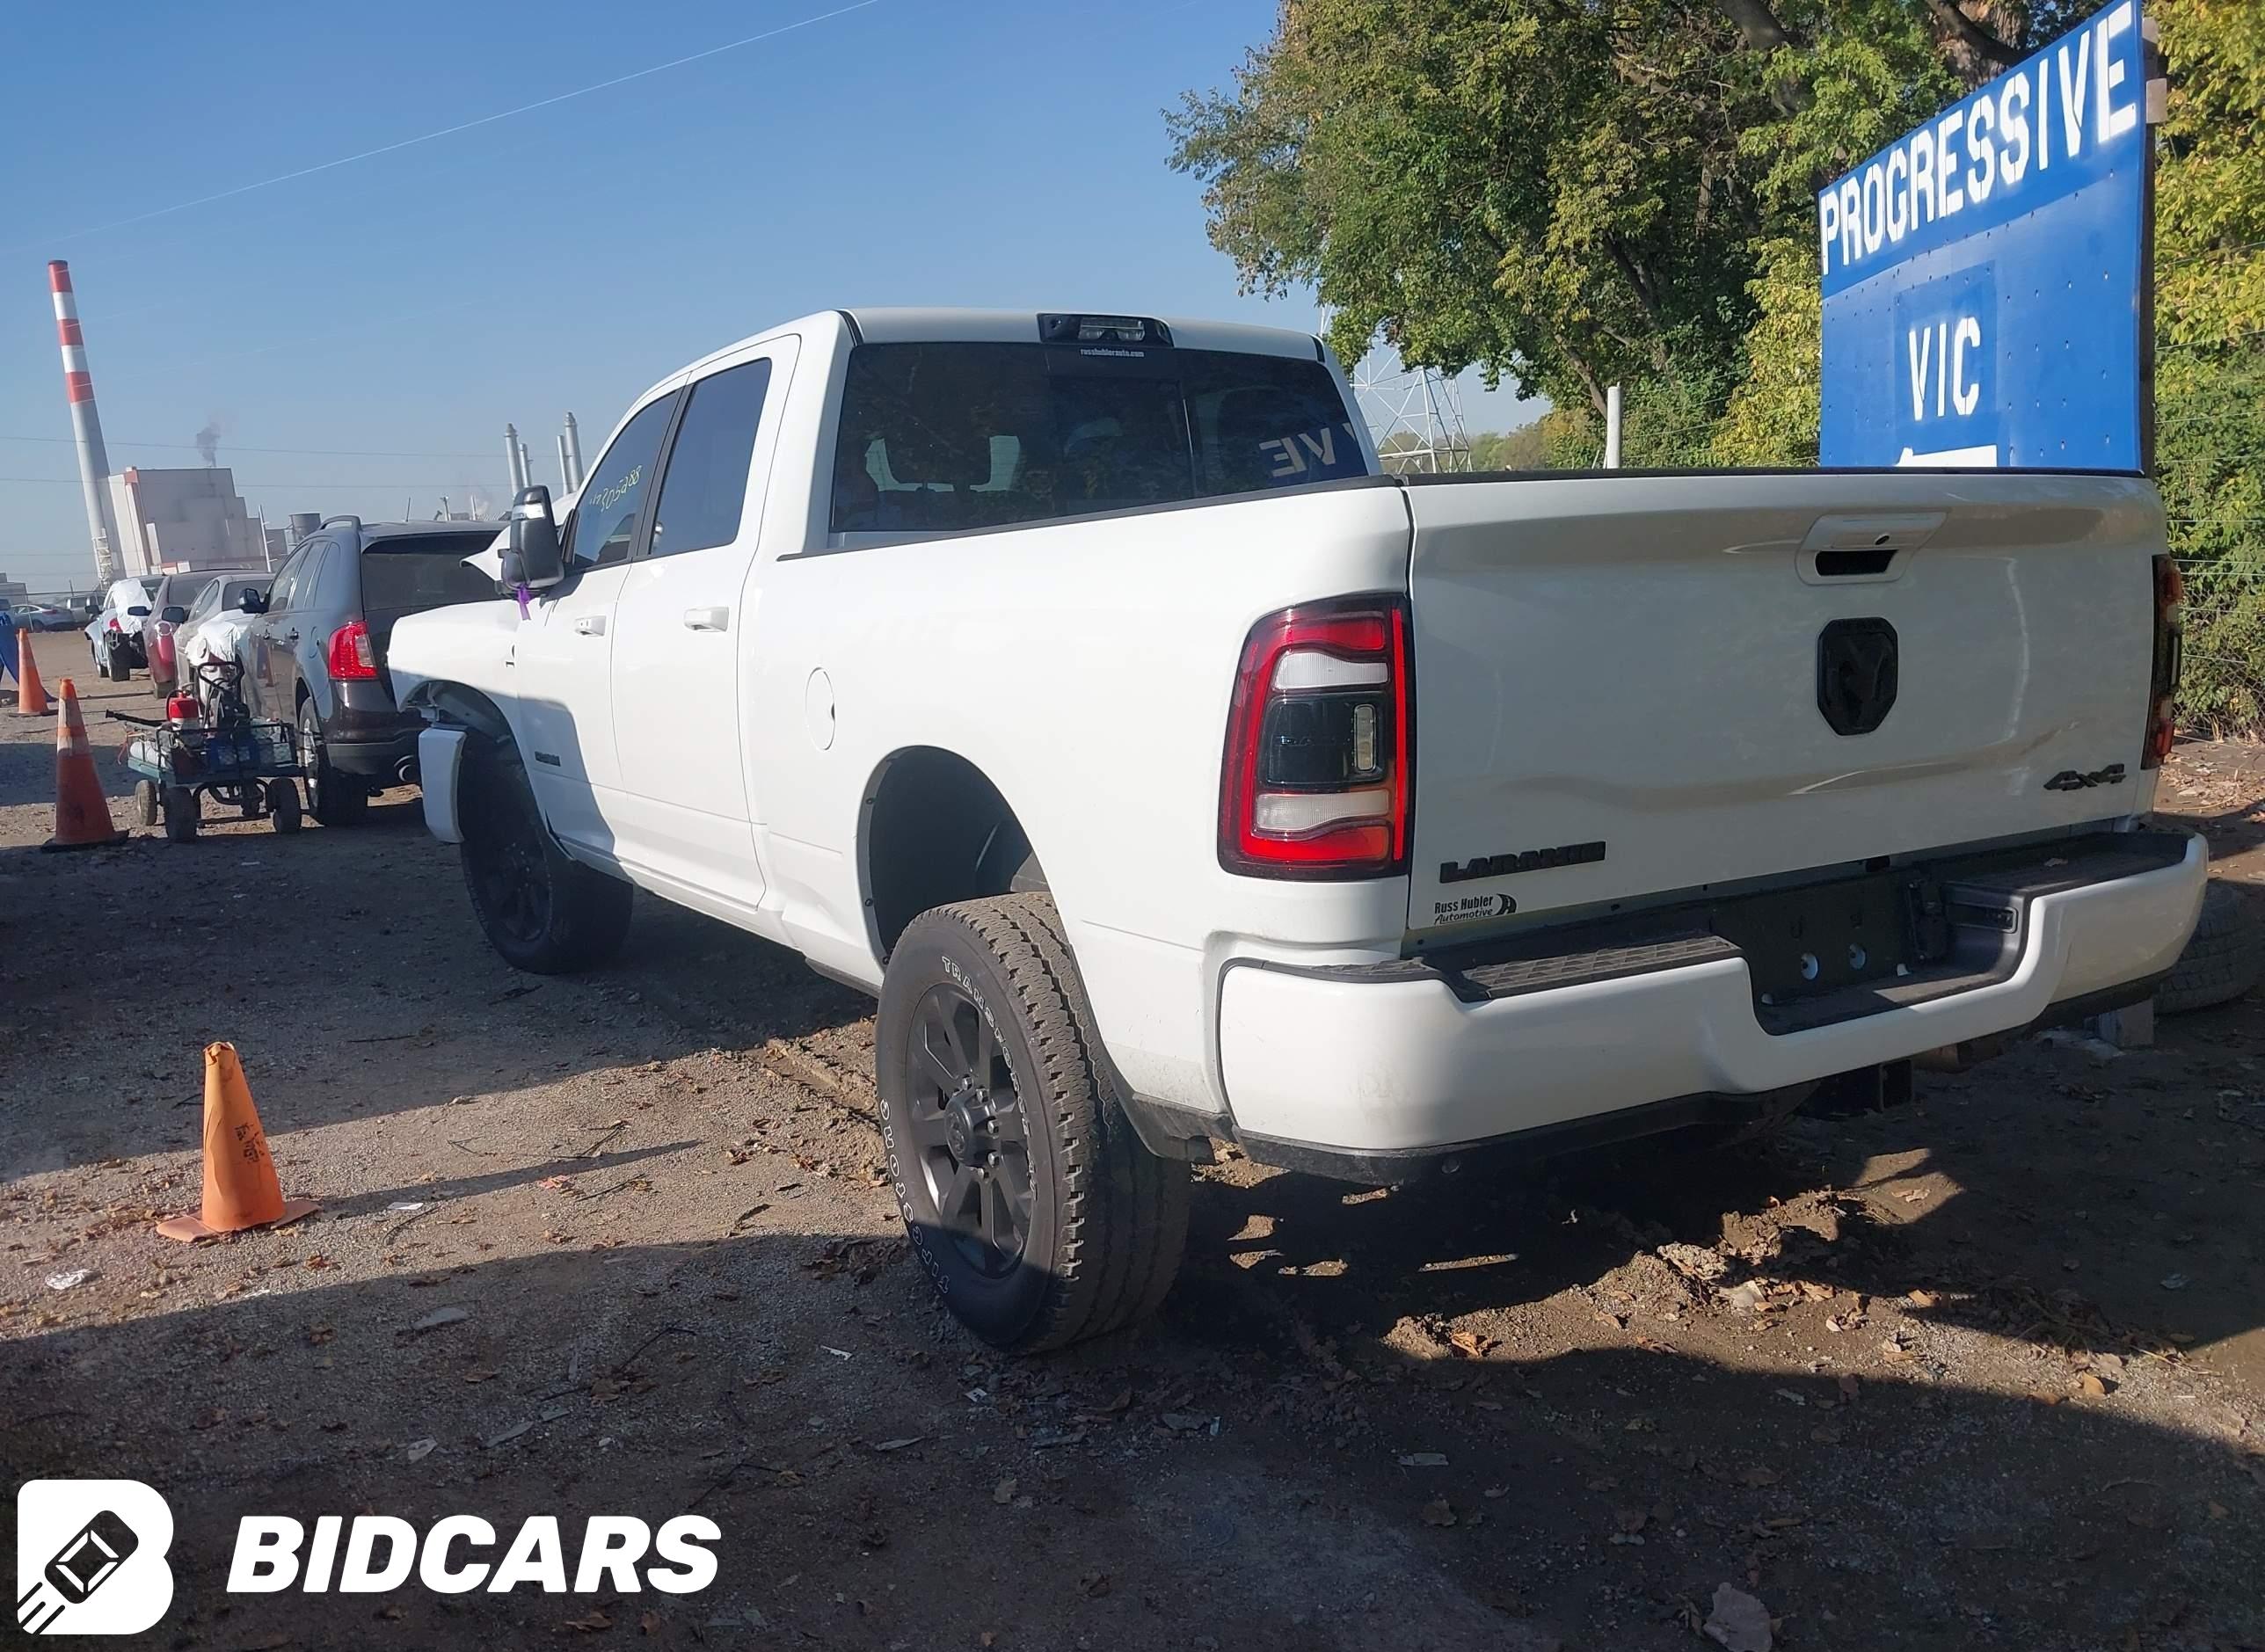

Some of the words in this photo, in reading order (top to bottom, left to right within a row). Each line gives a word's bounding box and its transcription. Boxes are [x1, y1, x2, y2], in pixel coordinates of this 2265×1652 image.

[1820, 2, 2137, 275] PROGRESSIVE
[1908, 317, 1981, 421] VIC
[1434, 900, 1459, 914] Russ
[1460, 895, 1494, 911] Hubler
[1434, 907, 1494, 925] Automotive
